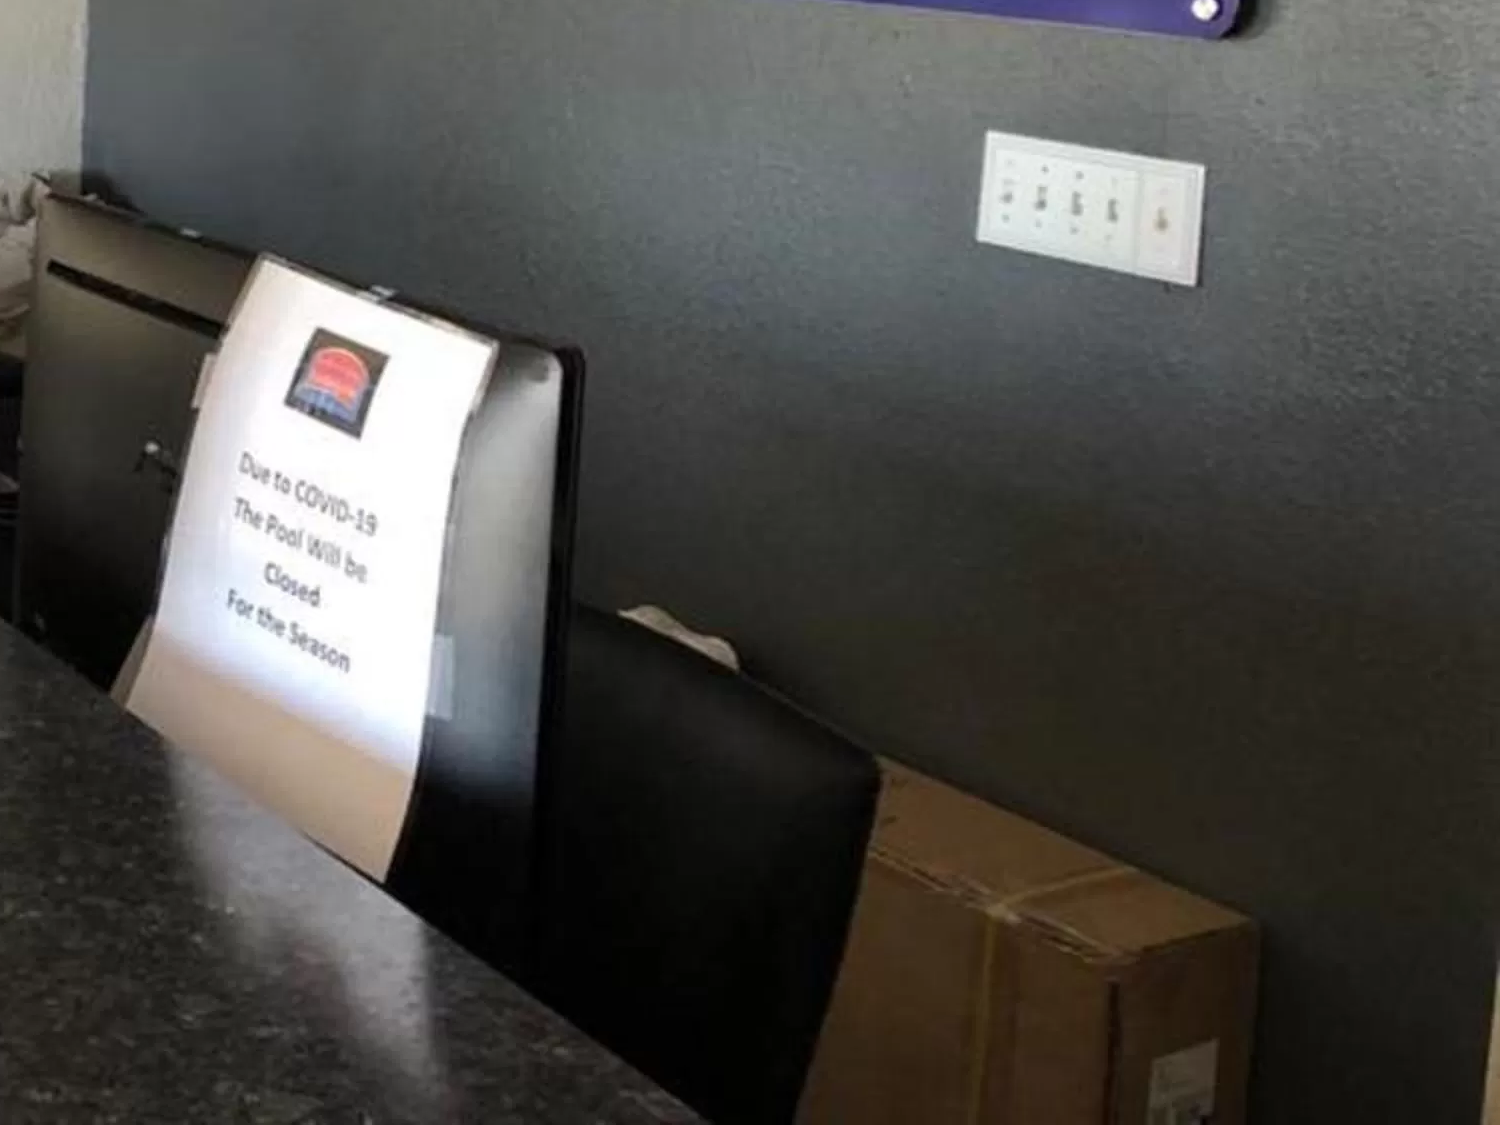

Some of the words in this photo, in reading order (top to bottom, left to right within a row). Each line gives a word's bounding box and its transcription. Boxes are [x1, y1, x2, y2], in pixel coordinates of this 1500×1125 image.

[239, 451, 271, 484] Due
[273, 471, 291, 495] to
[294, 479, 378, 537] COVID-19
[233, 496, 263, 530] The
[264, 514, 305, 549] Pool
[306, 534, 342, 568] Will
[344, 551, 368, 584] be
[263, 561, 322, 608] Closed
[226, 588, 254, 619] For
[255, 605, 286, 637] the
[288, 621, 351, 673] Season
